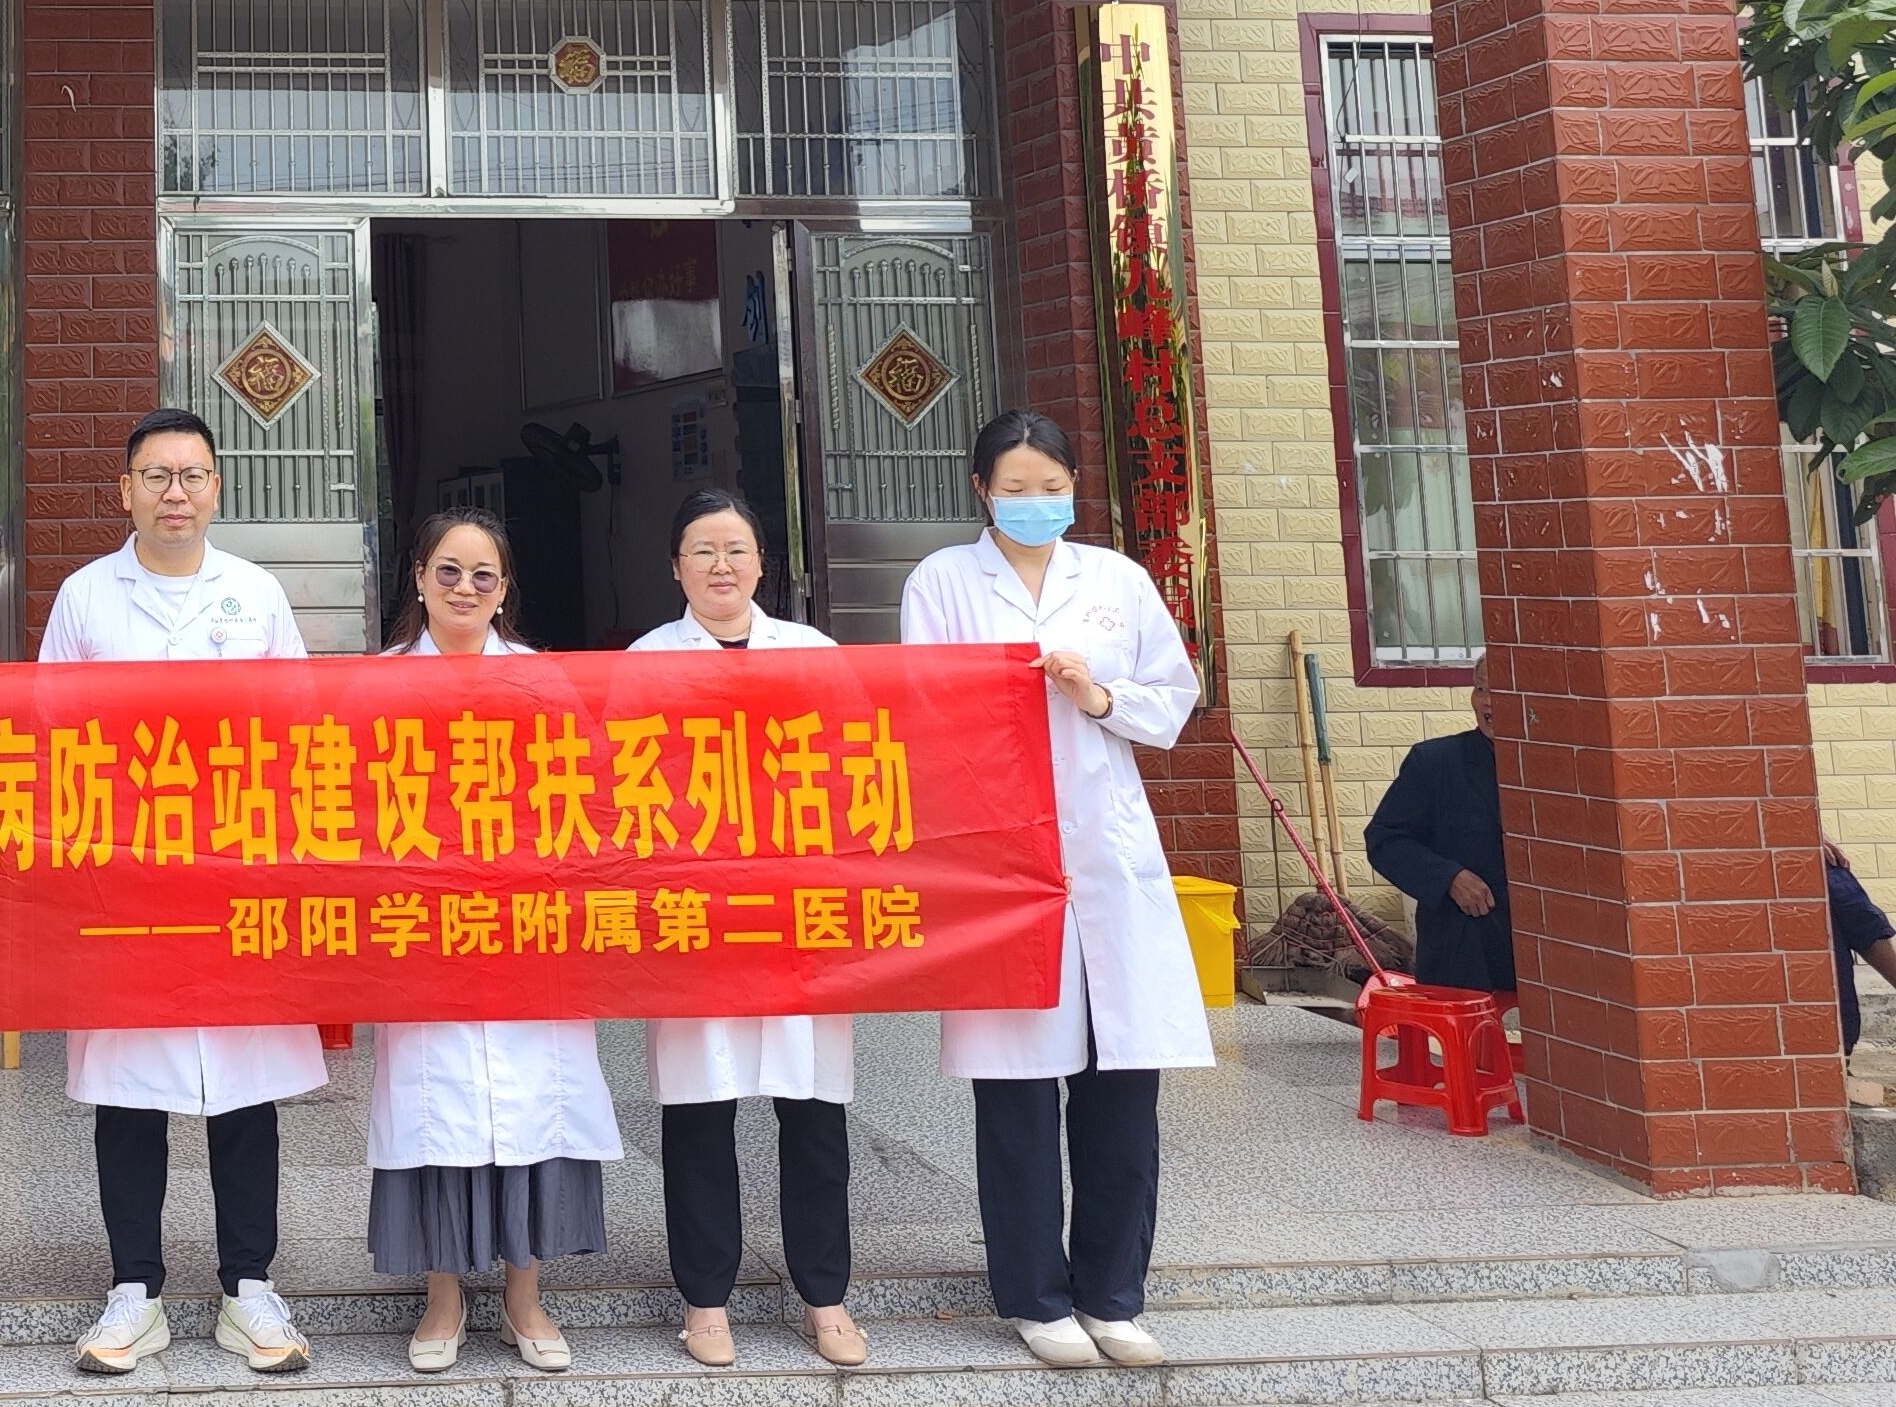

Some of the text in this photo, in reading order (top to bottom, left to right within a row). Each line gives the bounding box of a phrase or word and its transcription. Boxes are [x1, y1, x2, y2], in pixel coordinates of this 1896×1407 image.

[1101, 33, 1202, 673] 中共黄桥镇九峰村总支部委员
